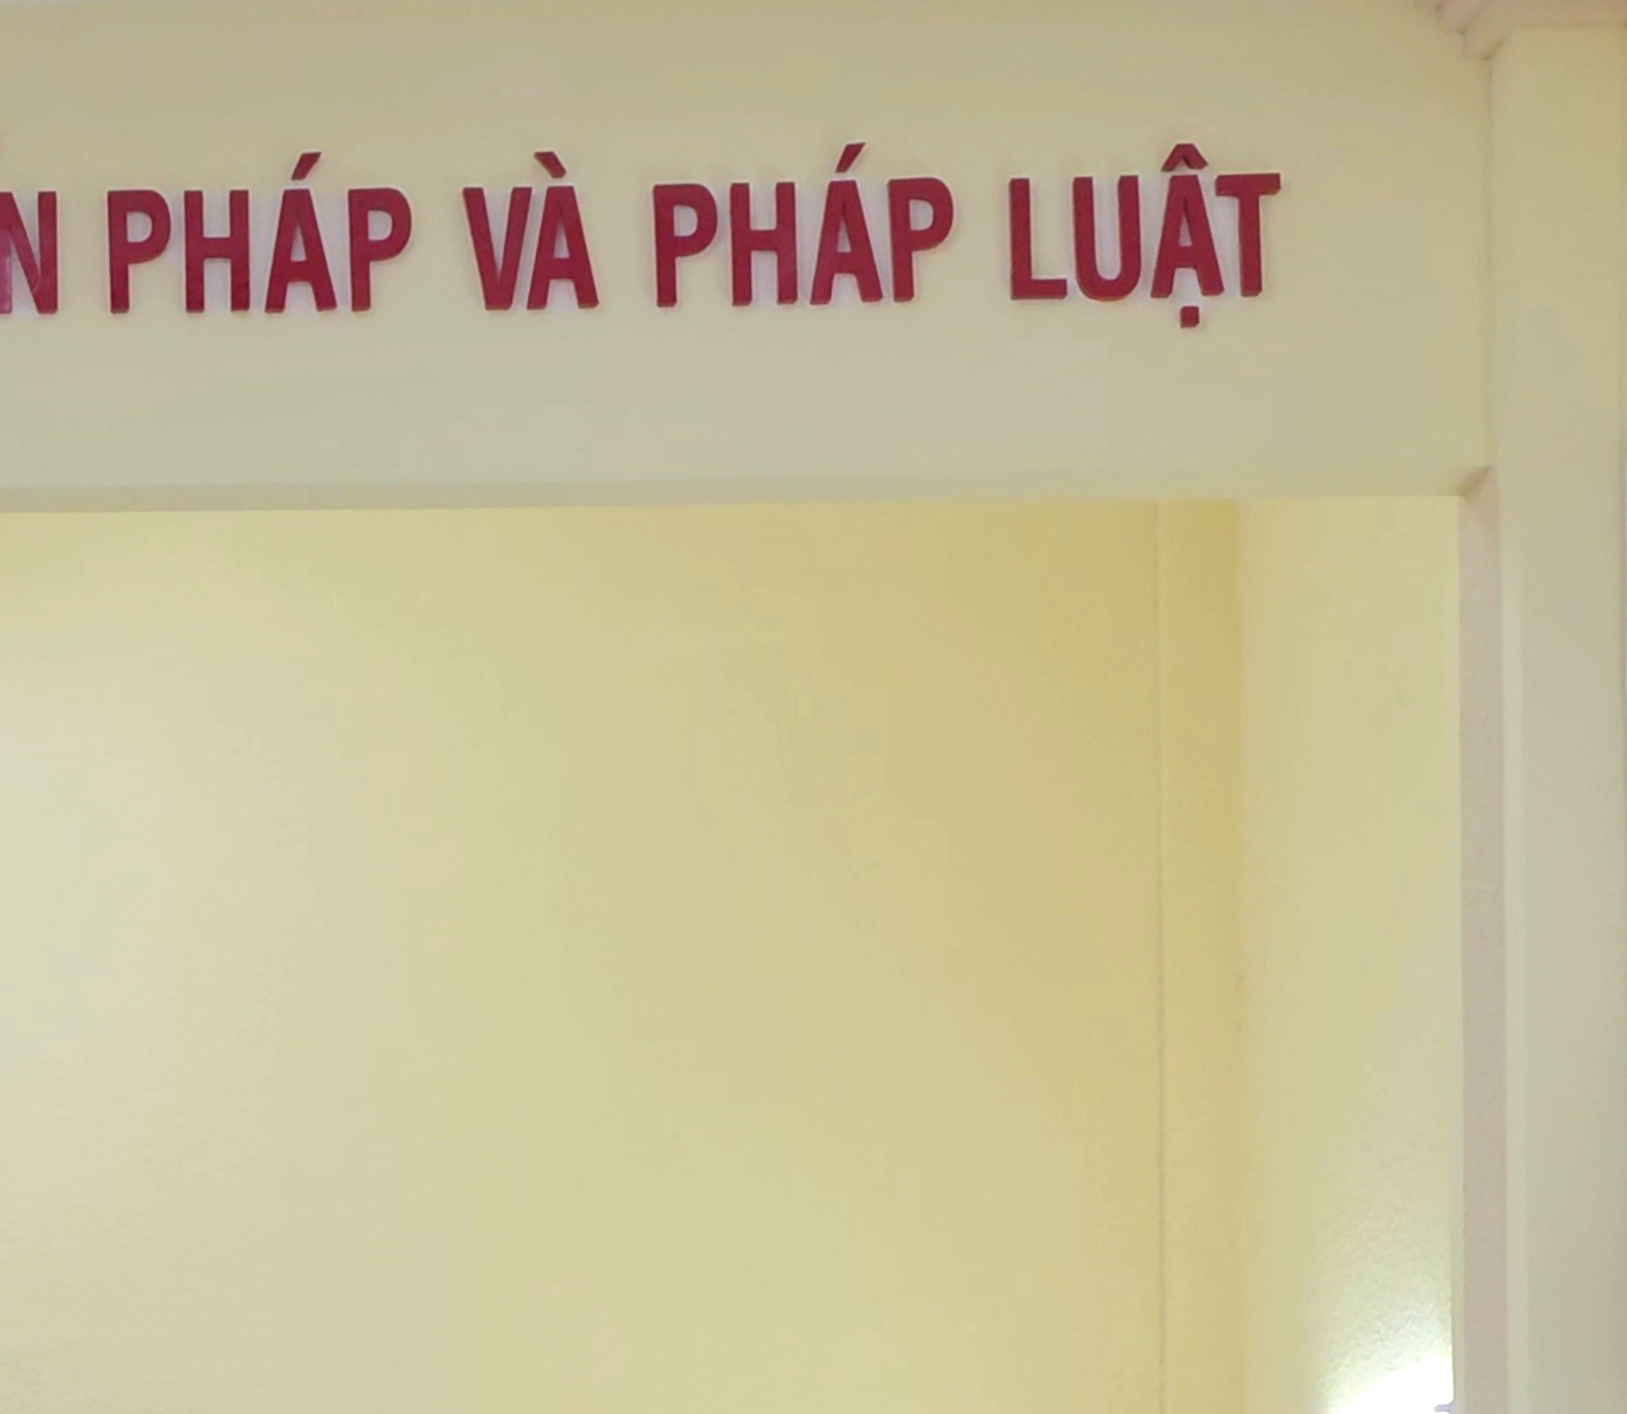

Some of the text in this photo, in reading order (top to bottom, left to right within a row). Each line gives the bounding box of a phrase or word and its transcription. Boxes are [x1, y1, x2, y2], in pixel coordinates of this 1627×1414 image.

[107, 153, 413, 314] PHÁP
[463, 151, 599, 310] VÀ
[653, 142, 955, 307] PHÁP
[1009, 143, 1282, 328] LUẬT
